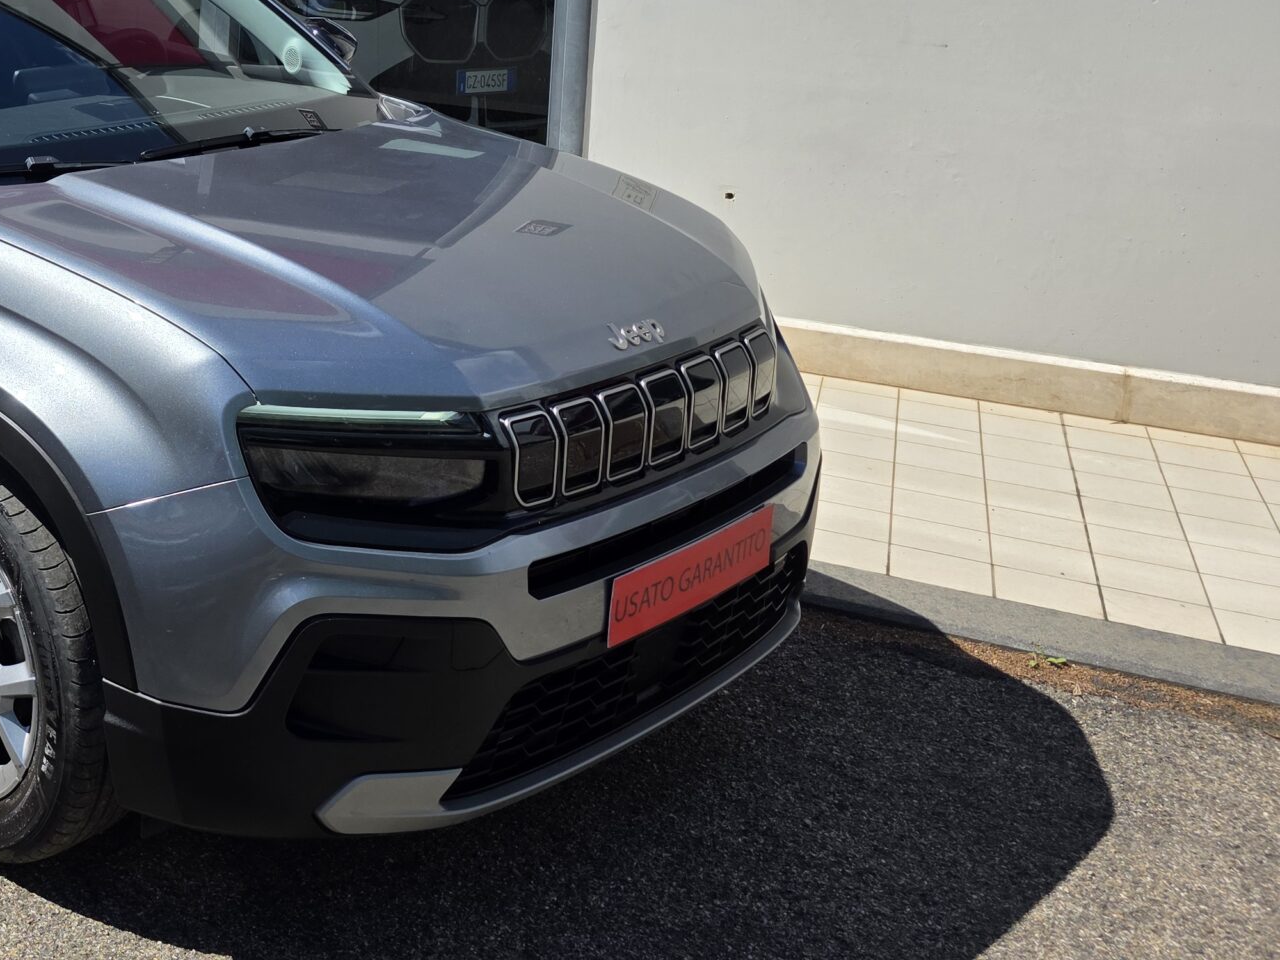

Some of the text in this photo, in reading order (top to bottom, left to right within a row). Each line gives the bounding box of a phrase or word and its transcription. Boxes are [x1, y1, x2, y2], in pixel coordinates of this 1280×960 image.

[606, 319, 665, 350] Jeep
[614, 527, 766, 623] USATO GARANTITO
